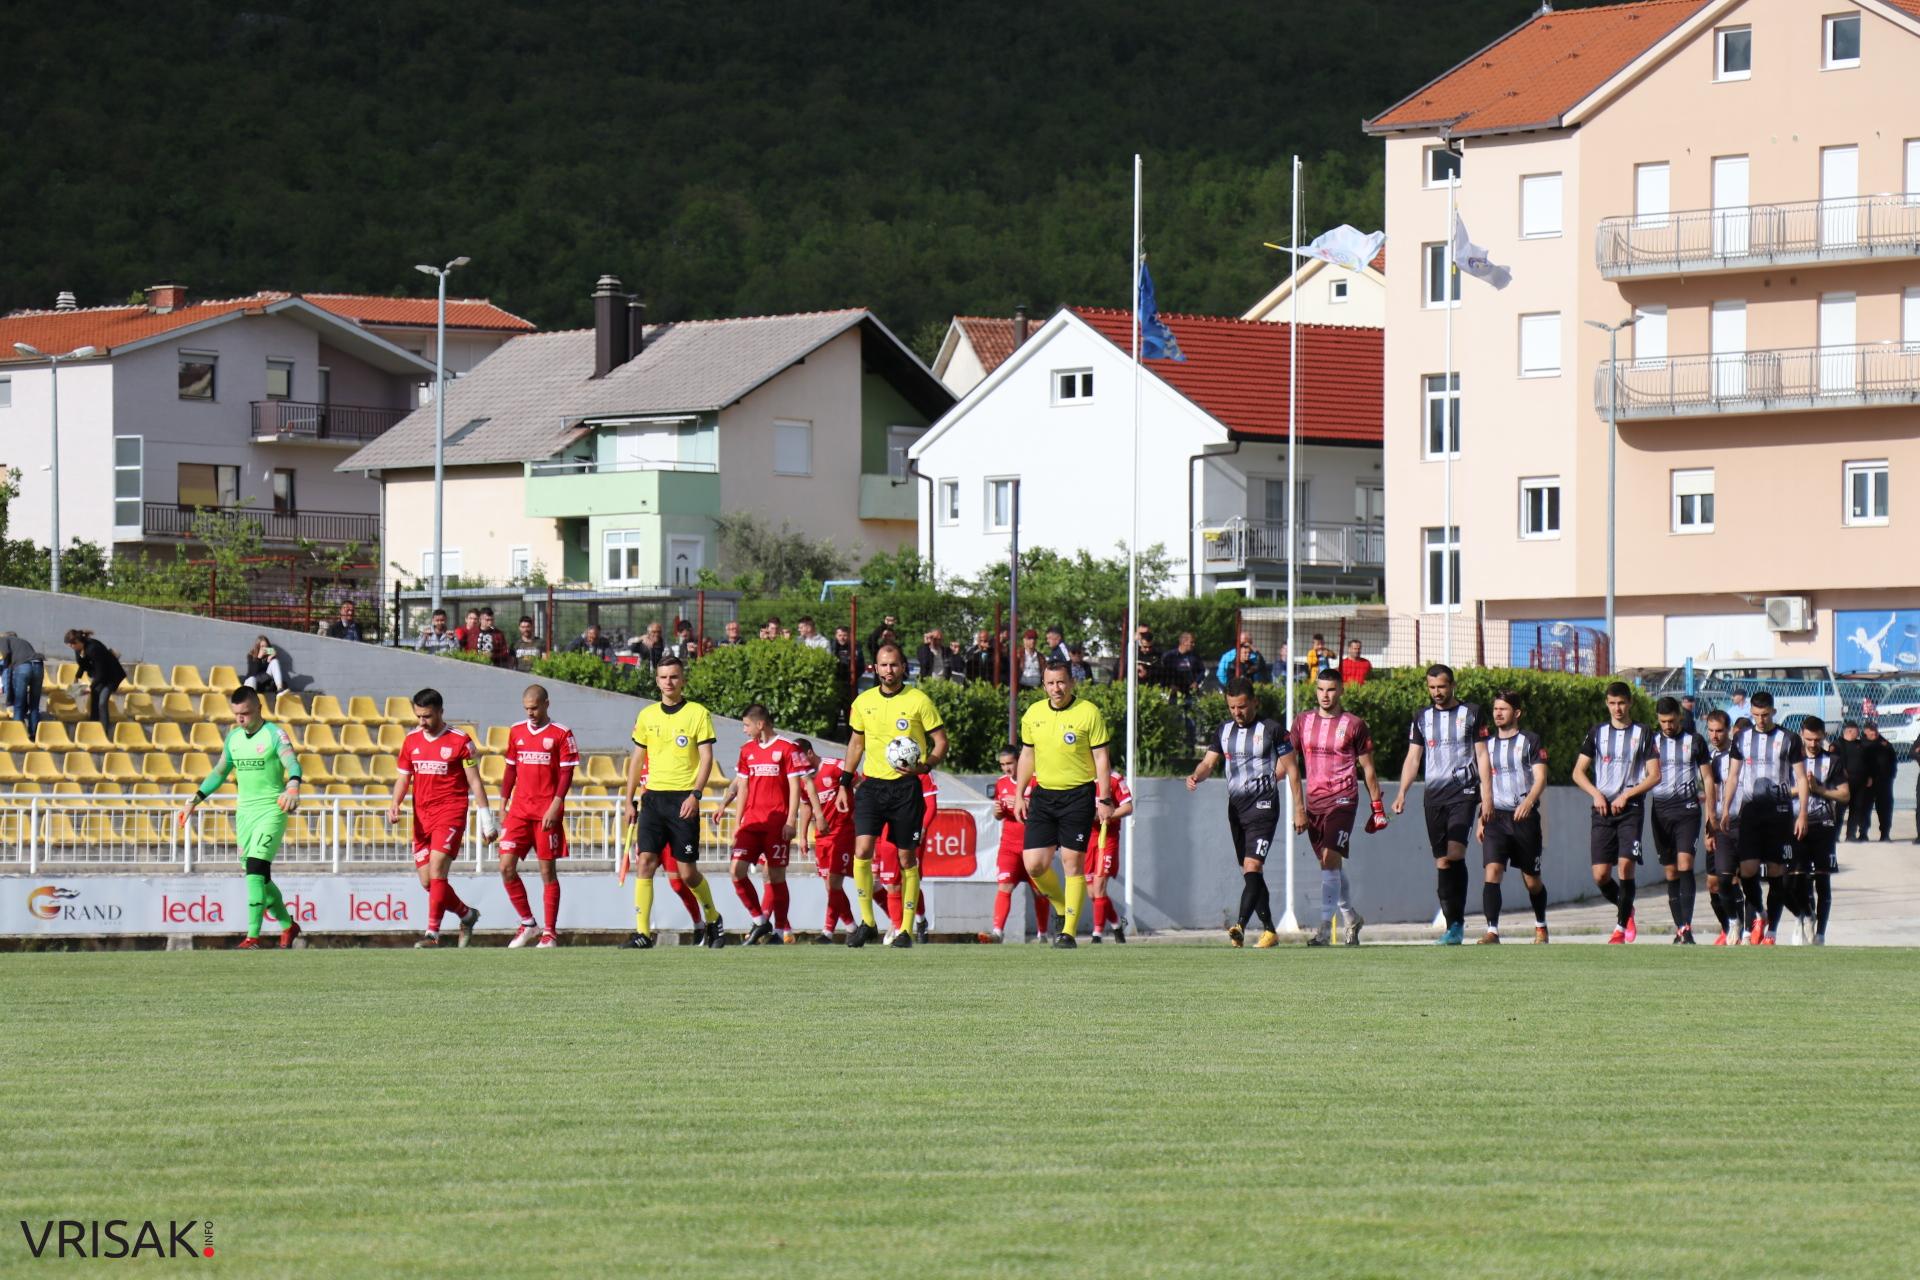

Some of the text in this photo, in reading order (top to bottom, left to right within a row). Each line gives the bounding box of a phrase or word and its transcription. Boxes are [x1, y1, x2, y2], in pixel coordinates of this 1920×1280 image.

[257, 832, 272, 849] 12
[445, 828, 457, 842] 7
[548, 834, 559, 849] 18
[927, 829, 967, 856] :tel
[1337, 830, 1349, 848] 12
[772, 844, 787, 859] 22
[1255, 838, 1269, 857] 13
[842, 853, 850, 866] 9
[1102, 855, 1112, 869] 5
[162, 895, 224, 922] leda
[350, 893, 408, 922] leda
